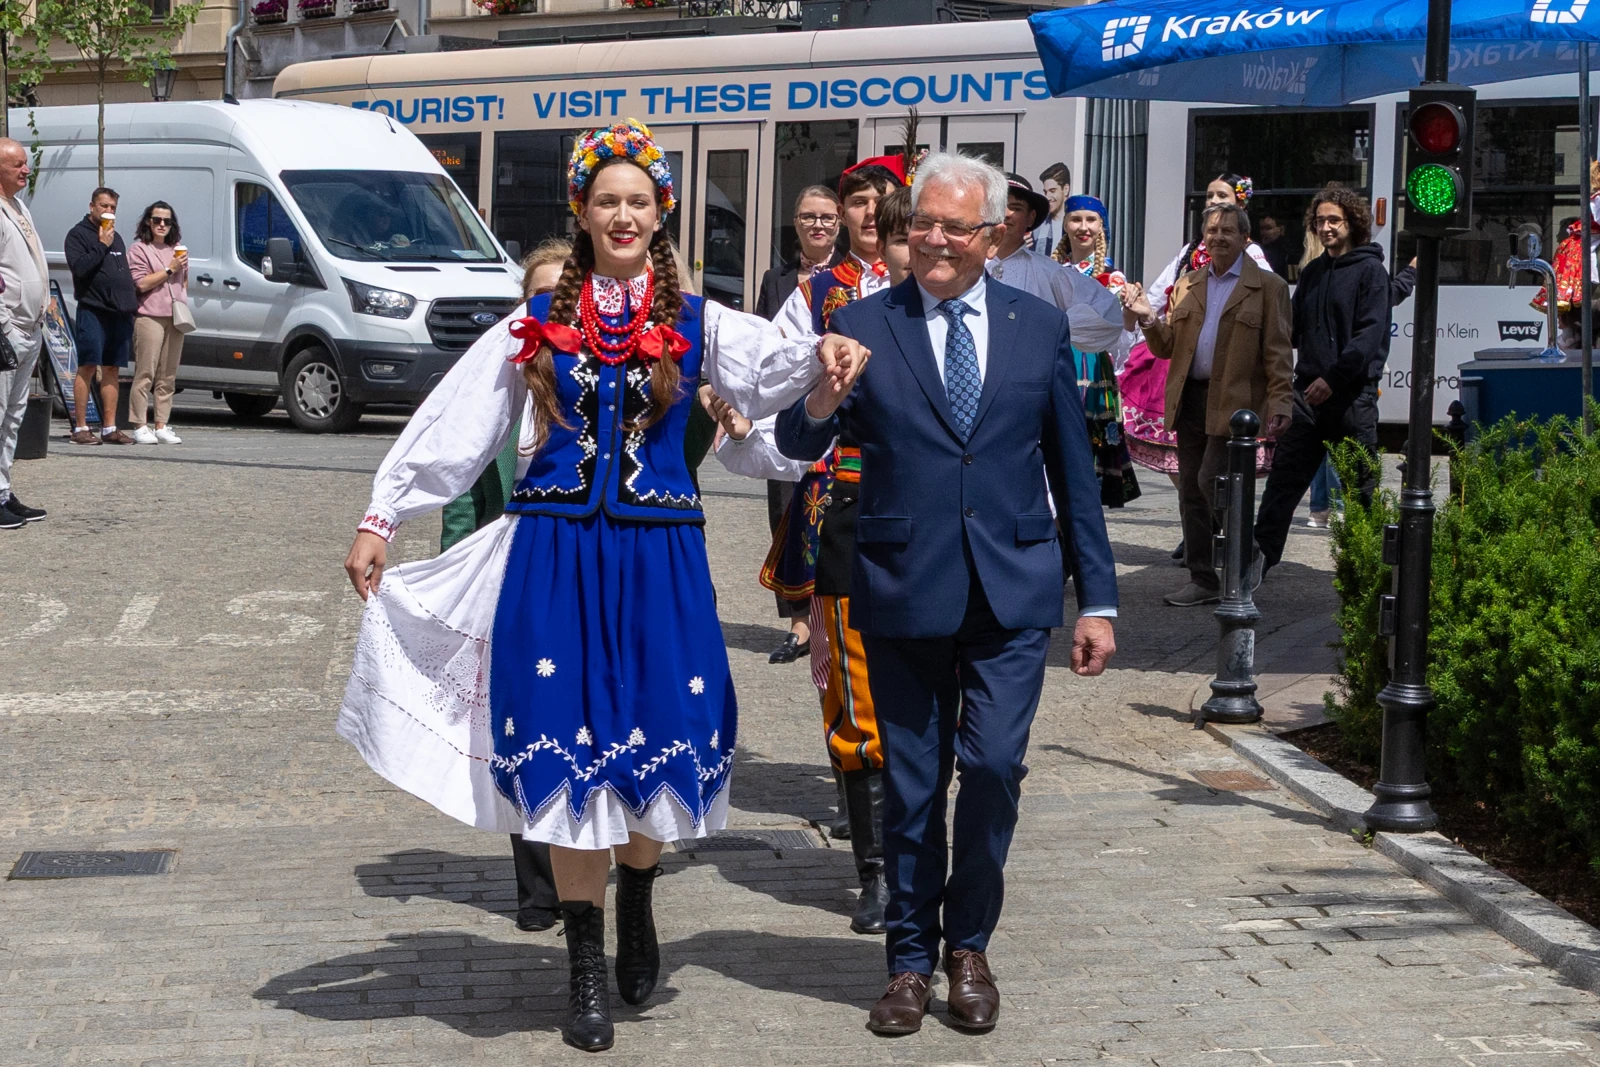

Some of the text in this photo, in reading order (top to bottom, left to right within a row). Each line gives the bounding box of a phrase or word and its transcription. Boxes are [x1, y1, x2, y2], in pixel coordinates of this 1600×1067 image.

[1161, 7, 1324, 42] Kraków
[533, 89, 627, 119] VISIT
[640, 83, 771, 115] THESE
[788, 70, 1052, 110] DISCOUNTS
[1447, 323, 1479, 338] Klein
